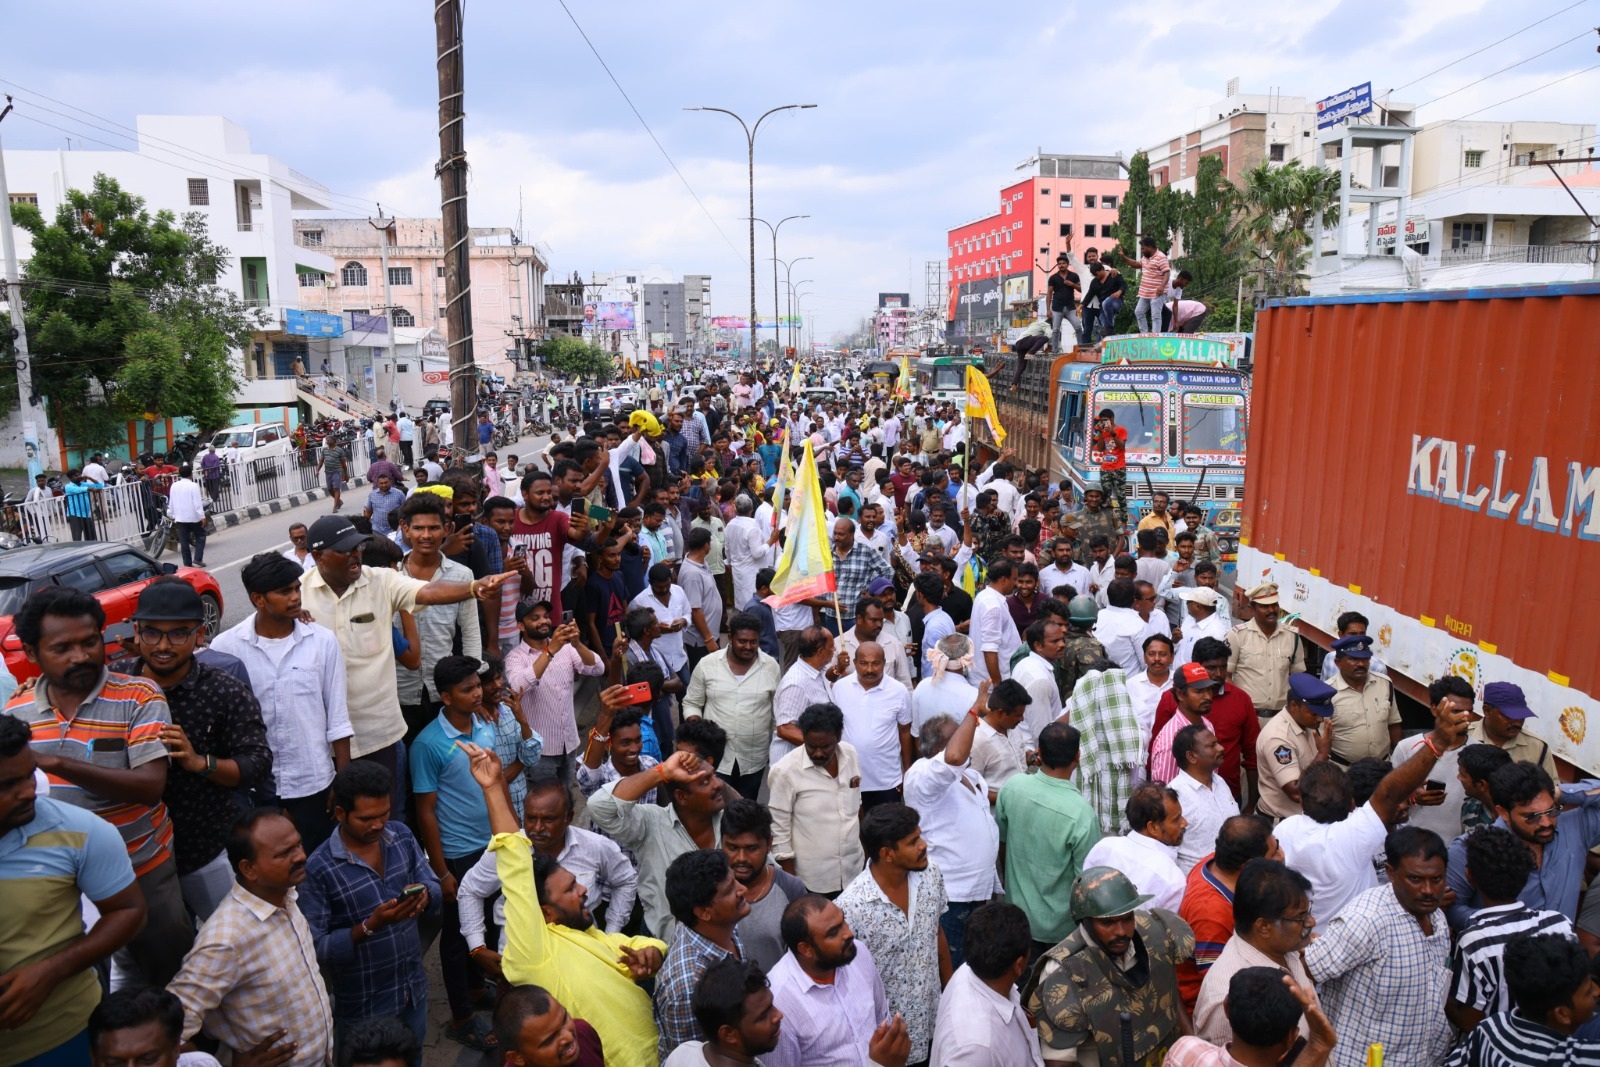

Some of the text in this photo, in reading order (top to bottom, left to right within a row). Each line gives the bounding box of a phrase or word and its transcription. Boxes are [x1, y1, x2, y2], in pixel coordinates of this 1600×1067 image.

[1109, 339, 1160, 360] MASHA
[1177, 339, 1228, 363] ALLAH
[1109, 373, 1158, 381] ZAHEER
[1189, 375, 1230, 384] TAMOTA KING
[1103, 392, 1152, 401] SHAMA
[1190, 394, 1236, 404] SAMEER
